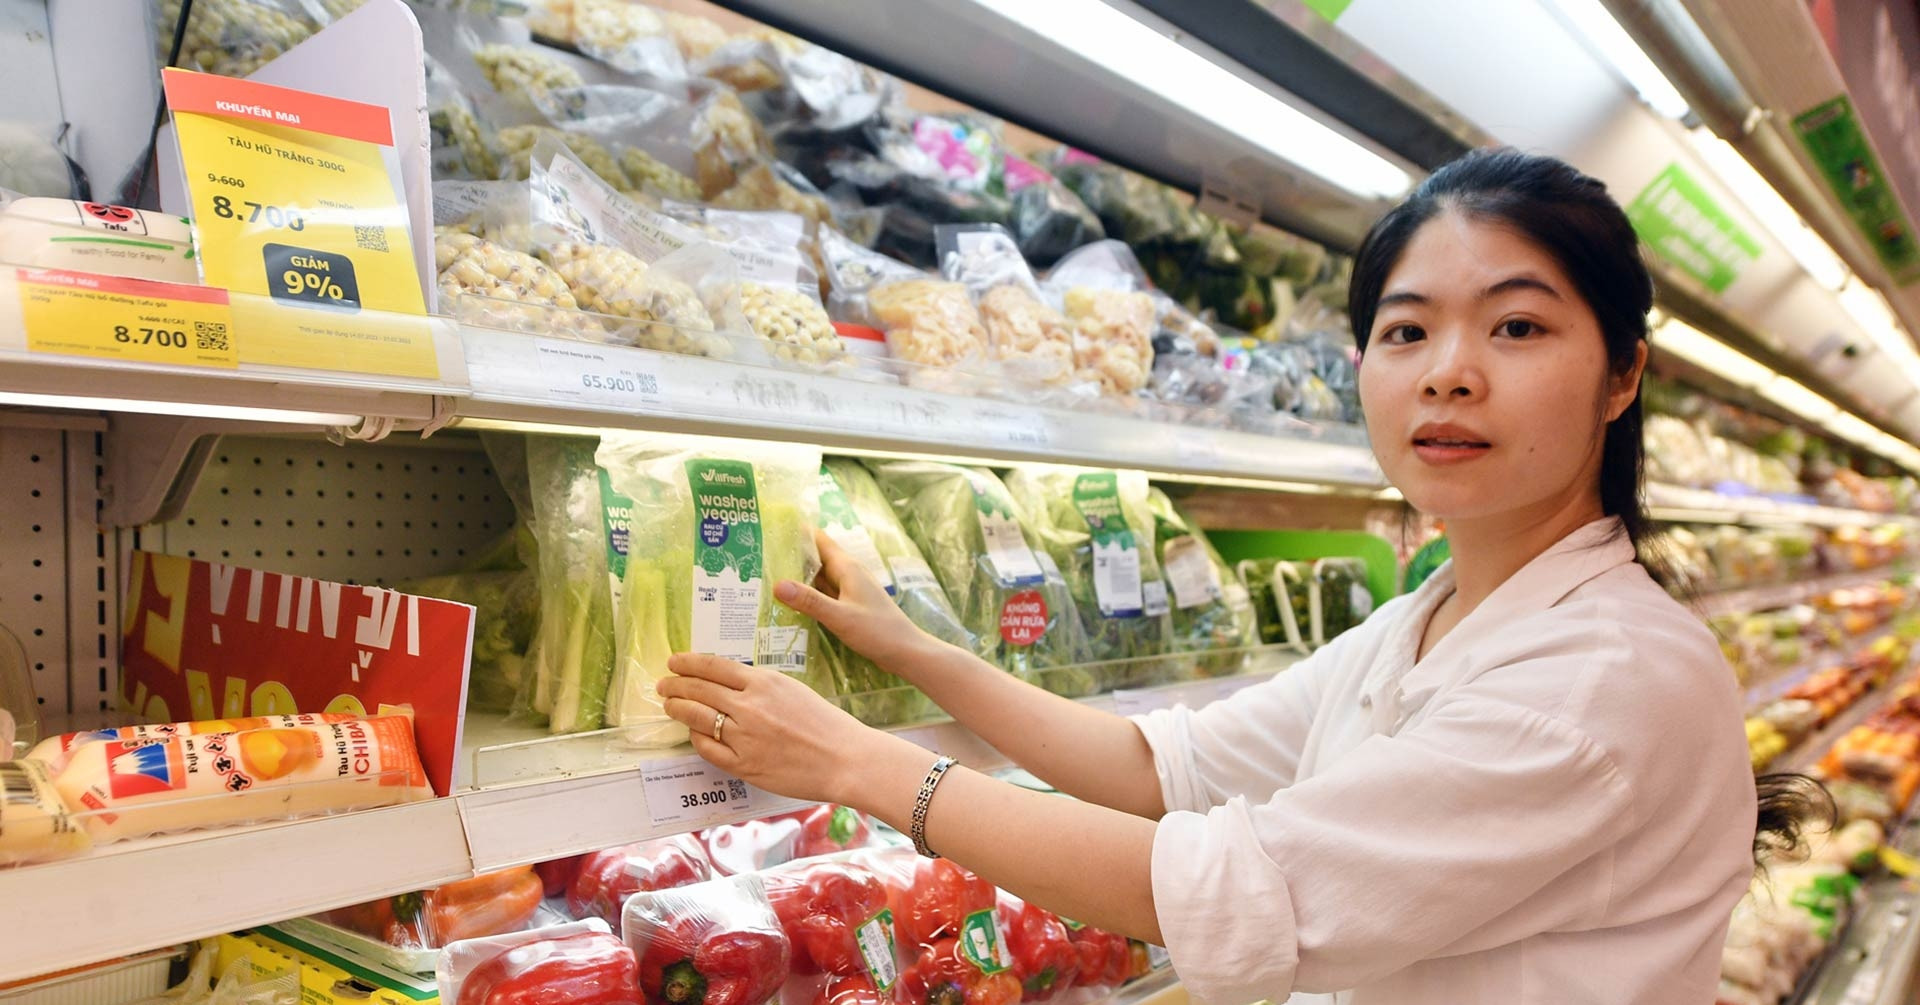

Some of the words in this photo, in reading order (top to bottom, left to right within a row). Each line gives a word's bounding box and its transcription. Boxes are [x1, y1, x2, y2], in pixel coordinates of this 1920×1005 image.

[216, 99, 272, 119] KHUYẾN
[227, 136, 252, 150] TÀU
[255, 143, 272, 155] HŨ
[317, 159, 345, 173] 300G
[207, 173, 245, 188] 9.600
[212, 194, 305, 231] 8.700
[102, 222, 128, 232] Tafu
[105, 248, 125, 258] Food
[127, 250, 138, 258] for
[140, 252, 166, 263] Family
[283, 270, 344, 300] 9%
[113, 325, 187, 349] 8.700
[582, 374, 635, 393] 65.900
[699, 494, 757, 510] washed
[701, 507, 759, 526] veggies
[335, 740, 347, 755] Hũ
[185, 753, 198, 774] Fuji
[338, 757, 348, 776] Tàu
[680, 790, 727, 808] 38.900
